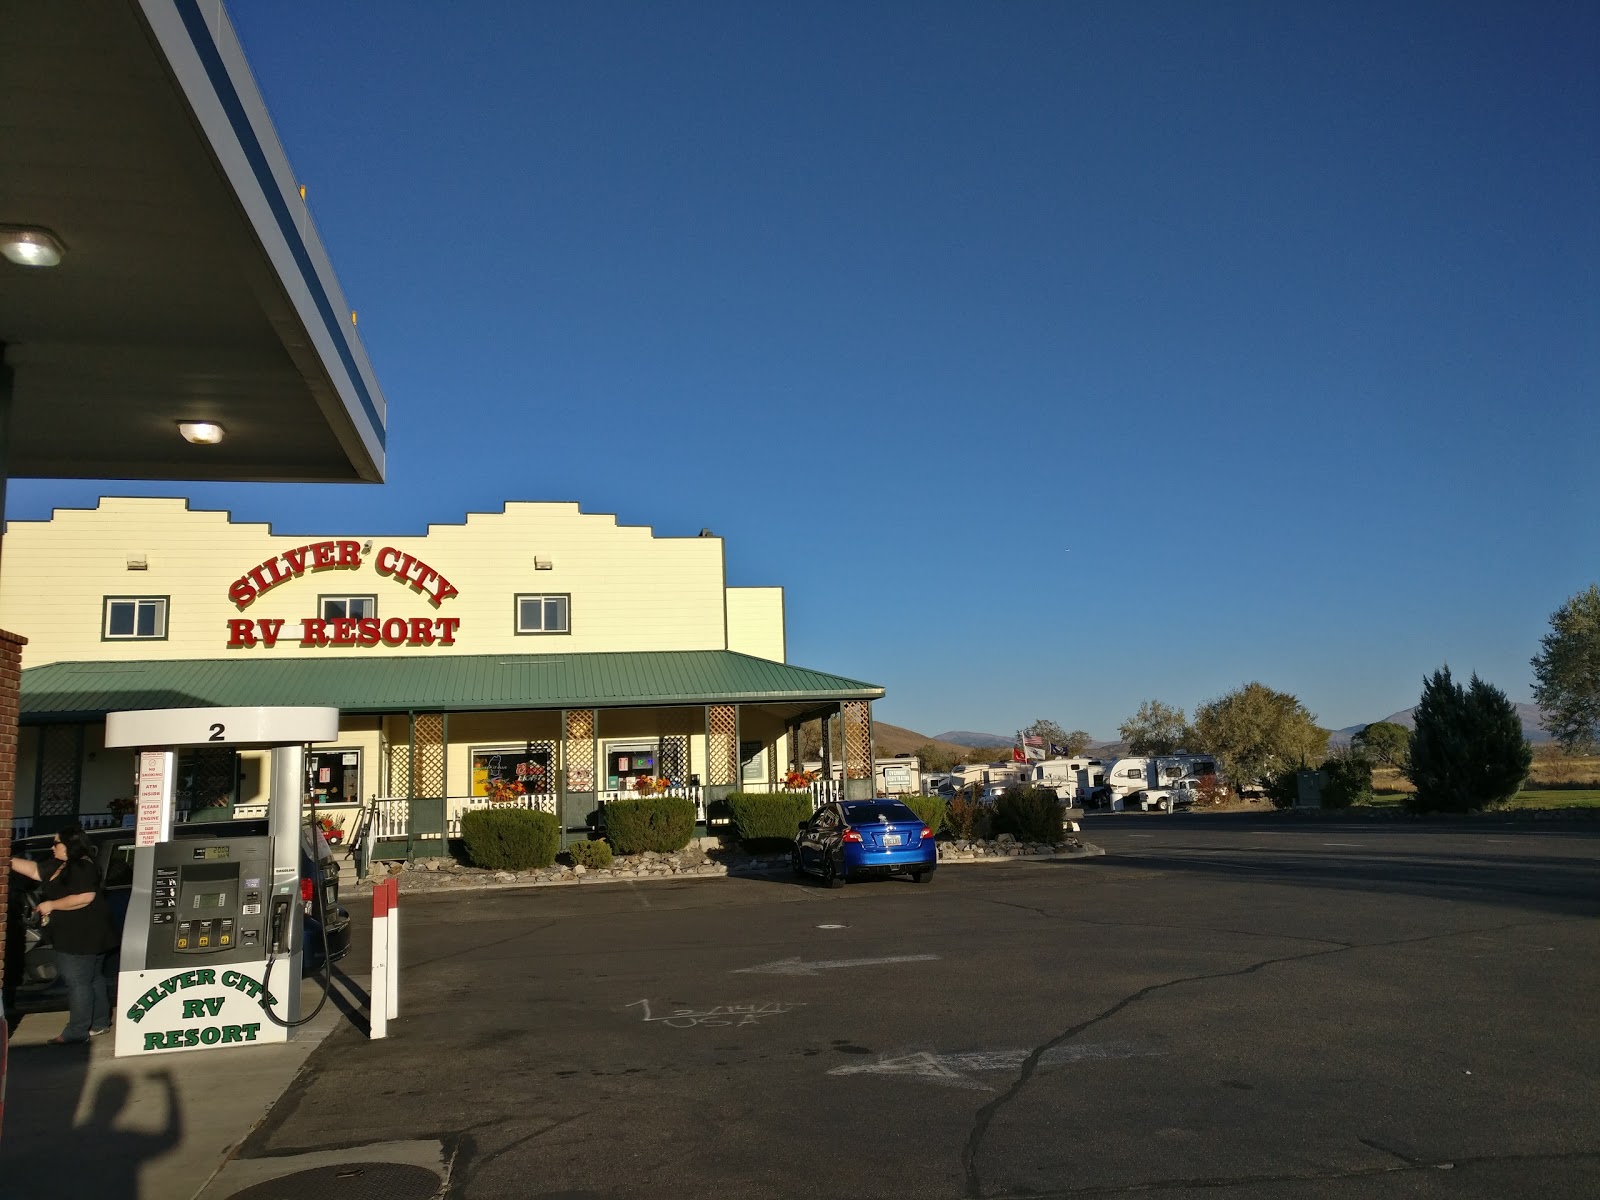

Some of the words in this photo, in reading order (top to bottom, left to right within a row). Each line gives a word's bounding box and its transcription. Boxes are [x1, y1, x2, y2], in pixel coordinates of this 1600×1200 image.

[228, 541, 362, 611] SILVER
[375, 547, 459, 609] CITY
[227, 619, 285, 648] RV
[299, 618, 460, 648] RESORT
[208, 723, 225, 741] 2
[126, 969, 216, 1024] SILVER
[221, 970, 279, 1009] CITY
[182, 997, 225, 1019] RV
[143, 1023, 260, 1050] RESORT
